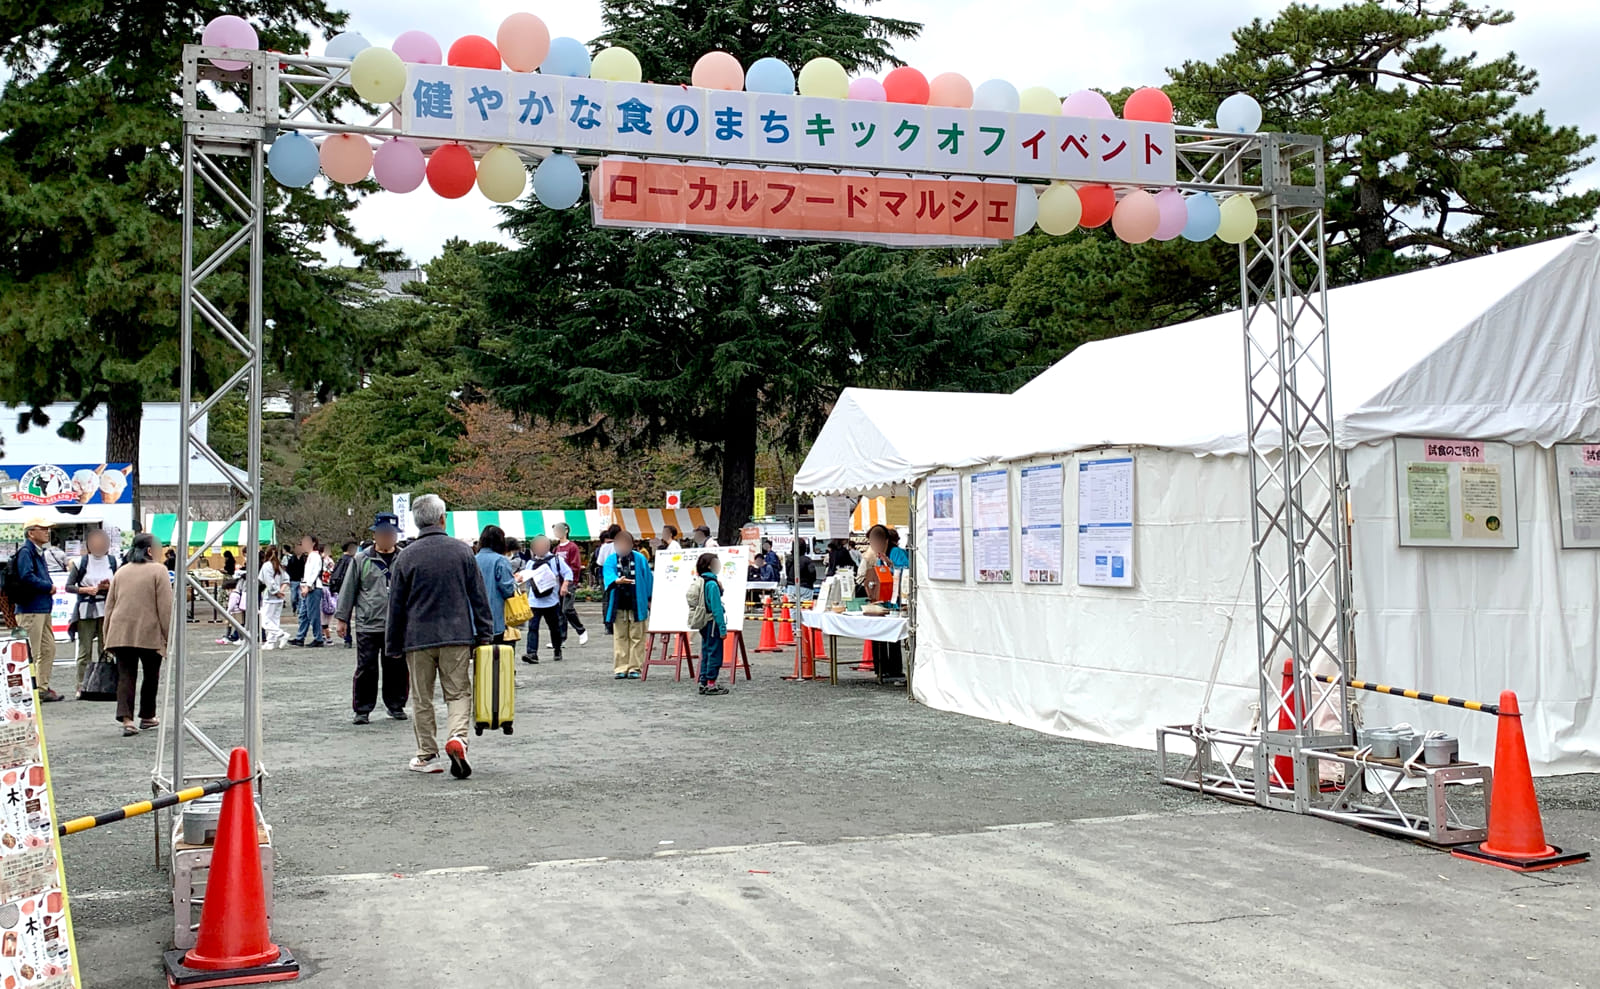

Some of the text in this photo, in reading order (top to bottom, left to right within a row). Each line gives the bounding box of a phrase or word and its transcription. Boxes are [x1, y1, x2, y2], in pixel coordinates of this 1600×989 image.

[413, 79, 1162, 165] 健やかな食のまちキックオフイベント
[609, 174, 1009, 223] ローカルフードマルシェ
[1428, 444, 1480, 457] 試食のご紹介
